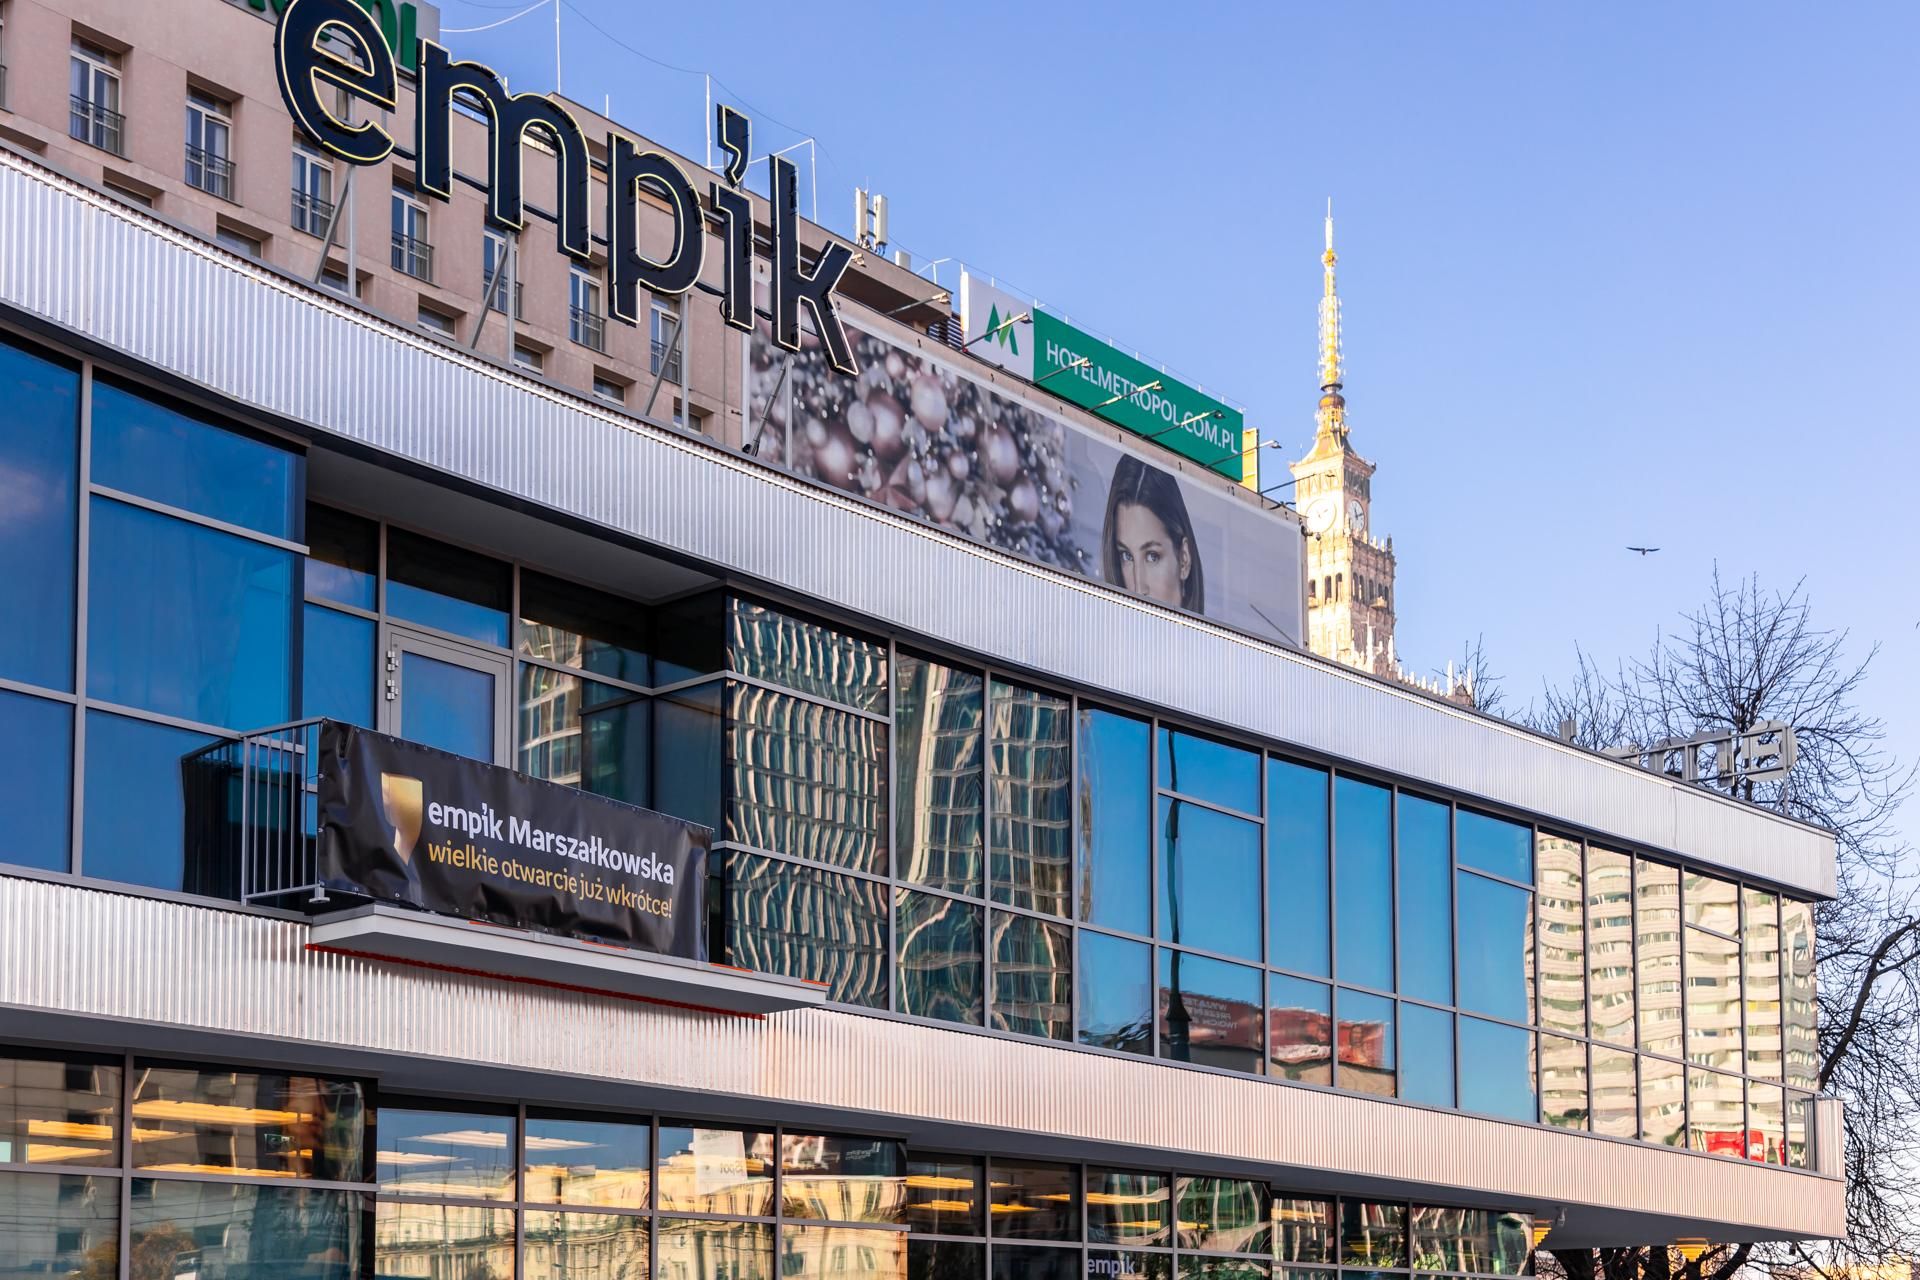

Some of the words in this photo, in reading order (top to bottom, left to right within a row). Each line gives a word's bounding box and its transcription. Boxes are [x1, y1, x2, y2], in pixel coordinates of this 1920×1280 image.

[274, 0, 859, 377] empik
[428, 801, 504, 841] empik
[509, 815, 674, 885] Marszałkowska
[428, 839, 498, 875] wielkie
[501, 858, 577, 893] otwarcie
[579, 872, 603, 900] już
[605, 883, 672, 918] wkrótce!
[1088, 1255, 1136, 1278] empik
